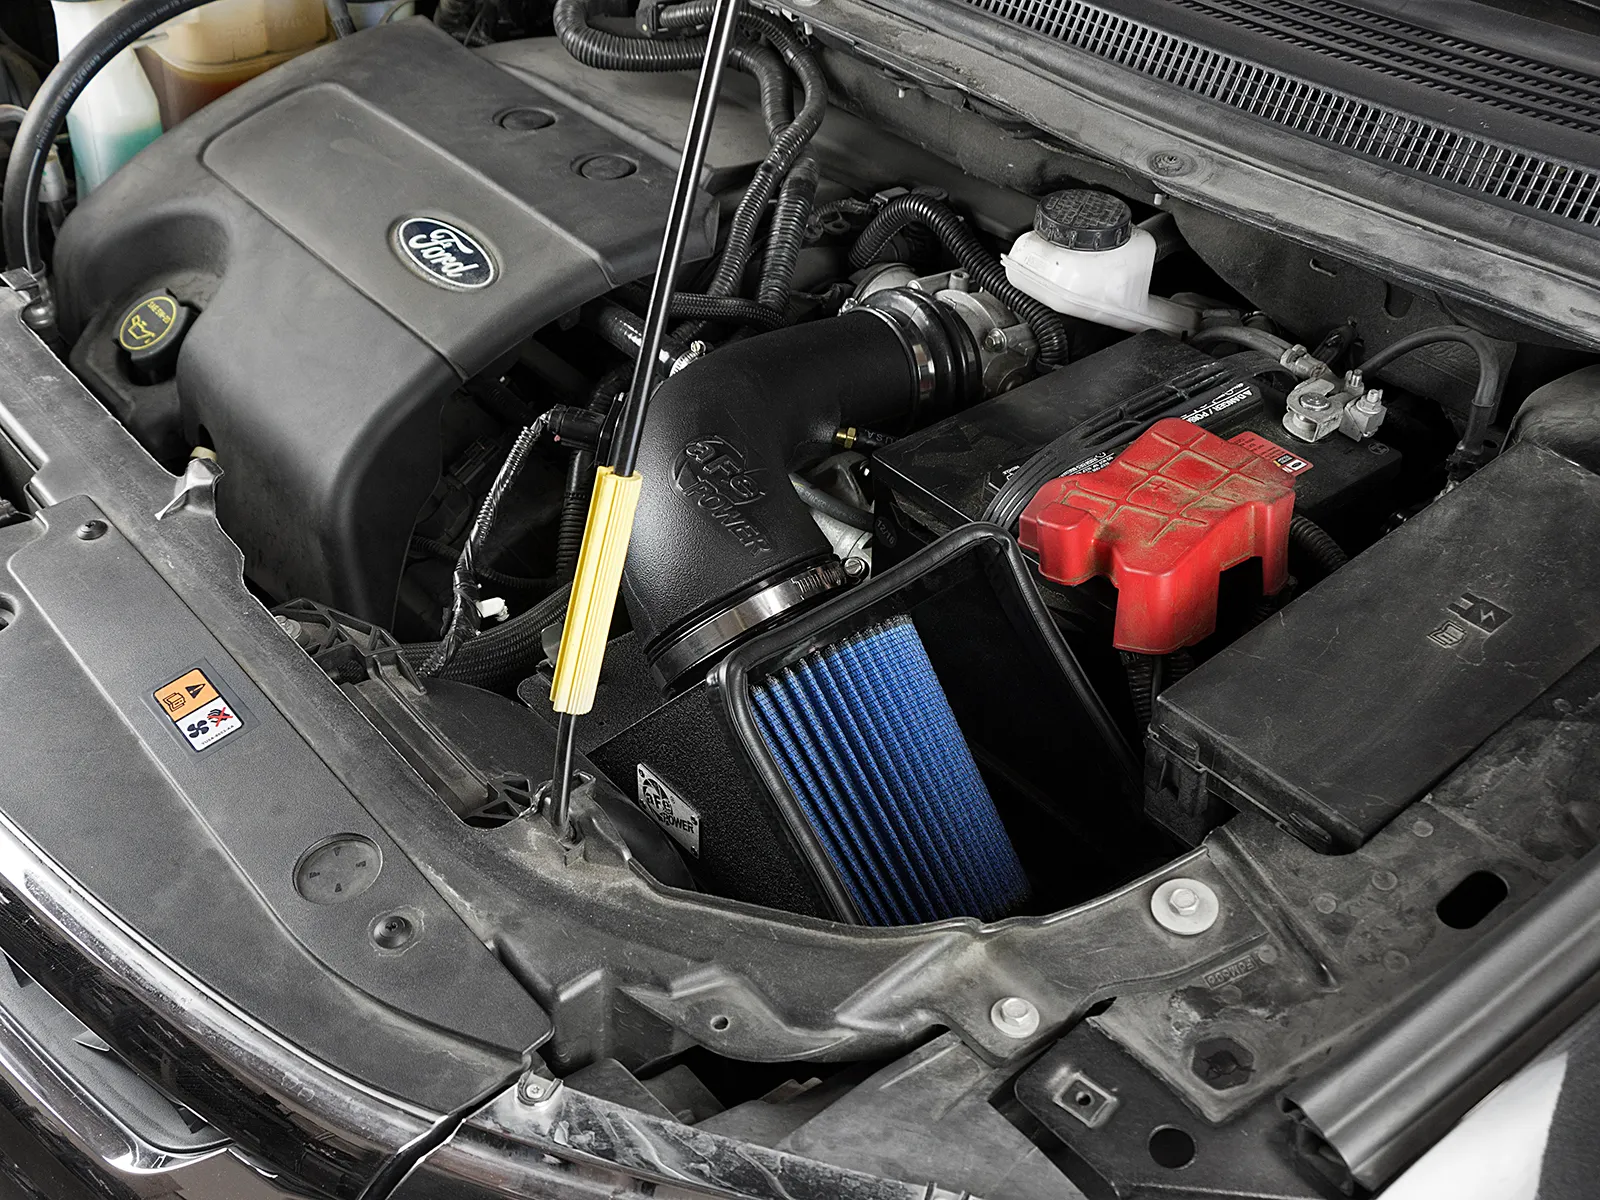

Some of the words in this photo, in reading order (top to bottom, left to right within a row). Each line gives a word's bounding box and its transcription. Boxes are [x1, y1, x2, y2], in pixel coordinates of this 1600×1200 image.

[408, 228, 480, 278] Ford
[1214, 392, 1248, 412] DANGER
[681, 478, 772, 557] POWER
[660, 812, 695, 834] POWER
